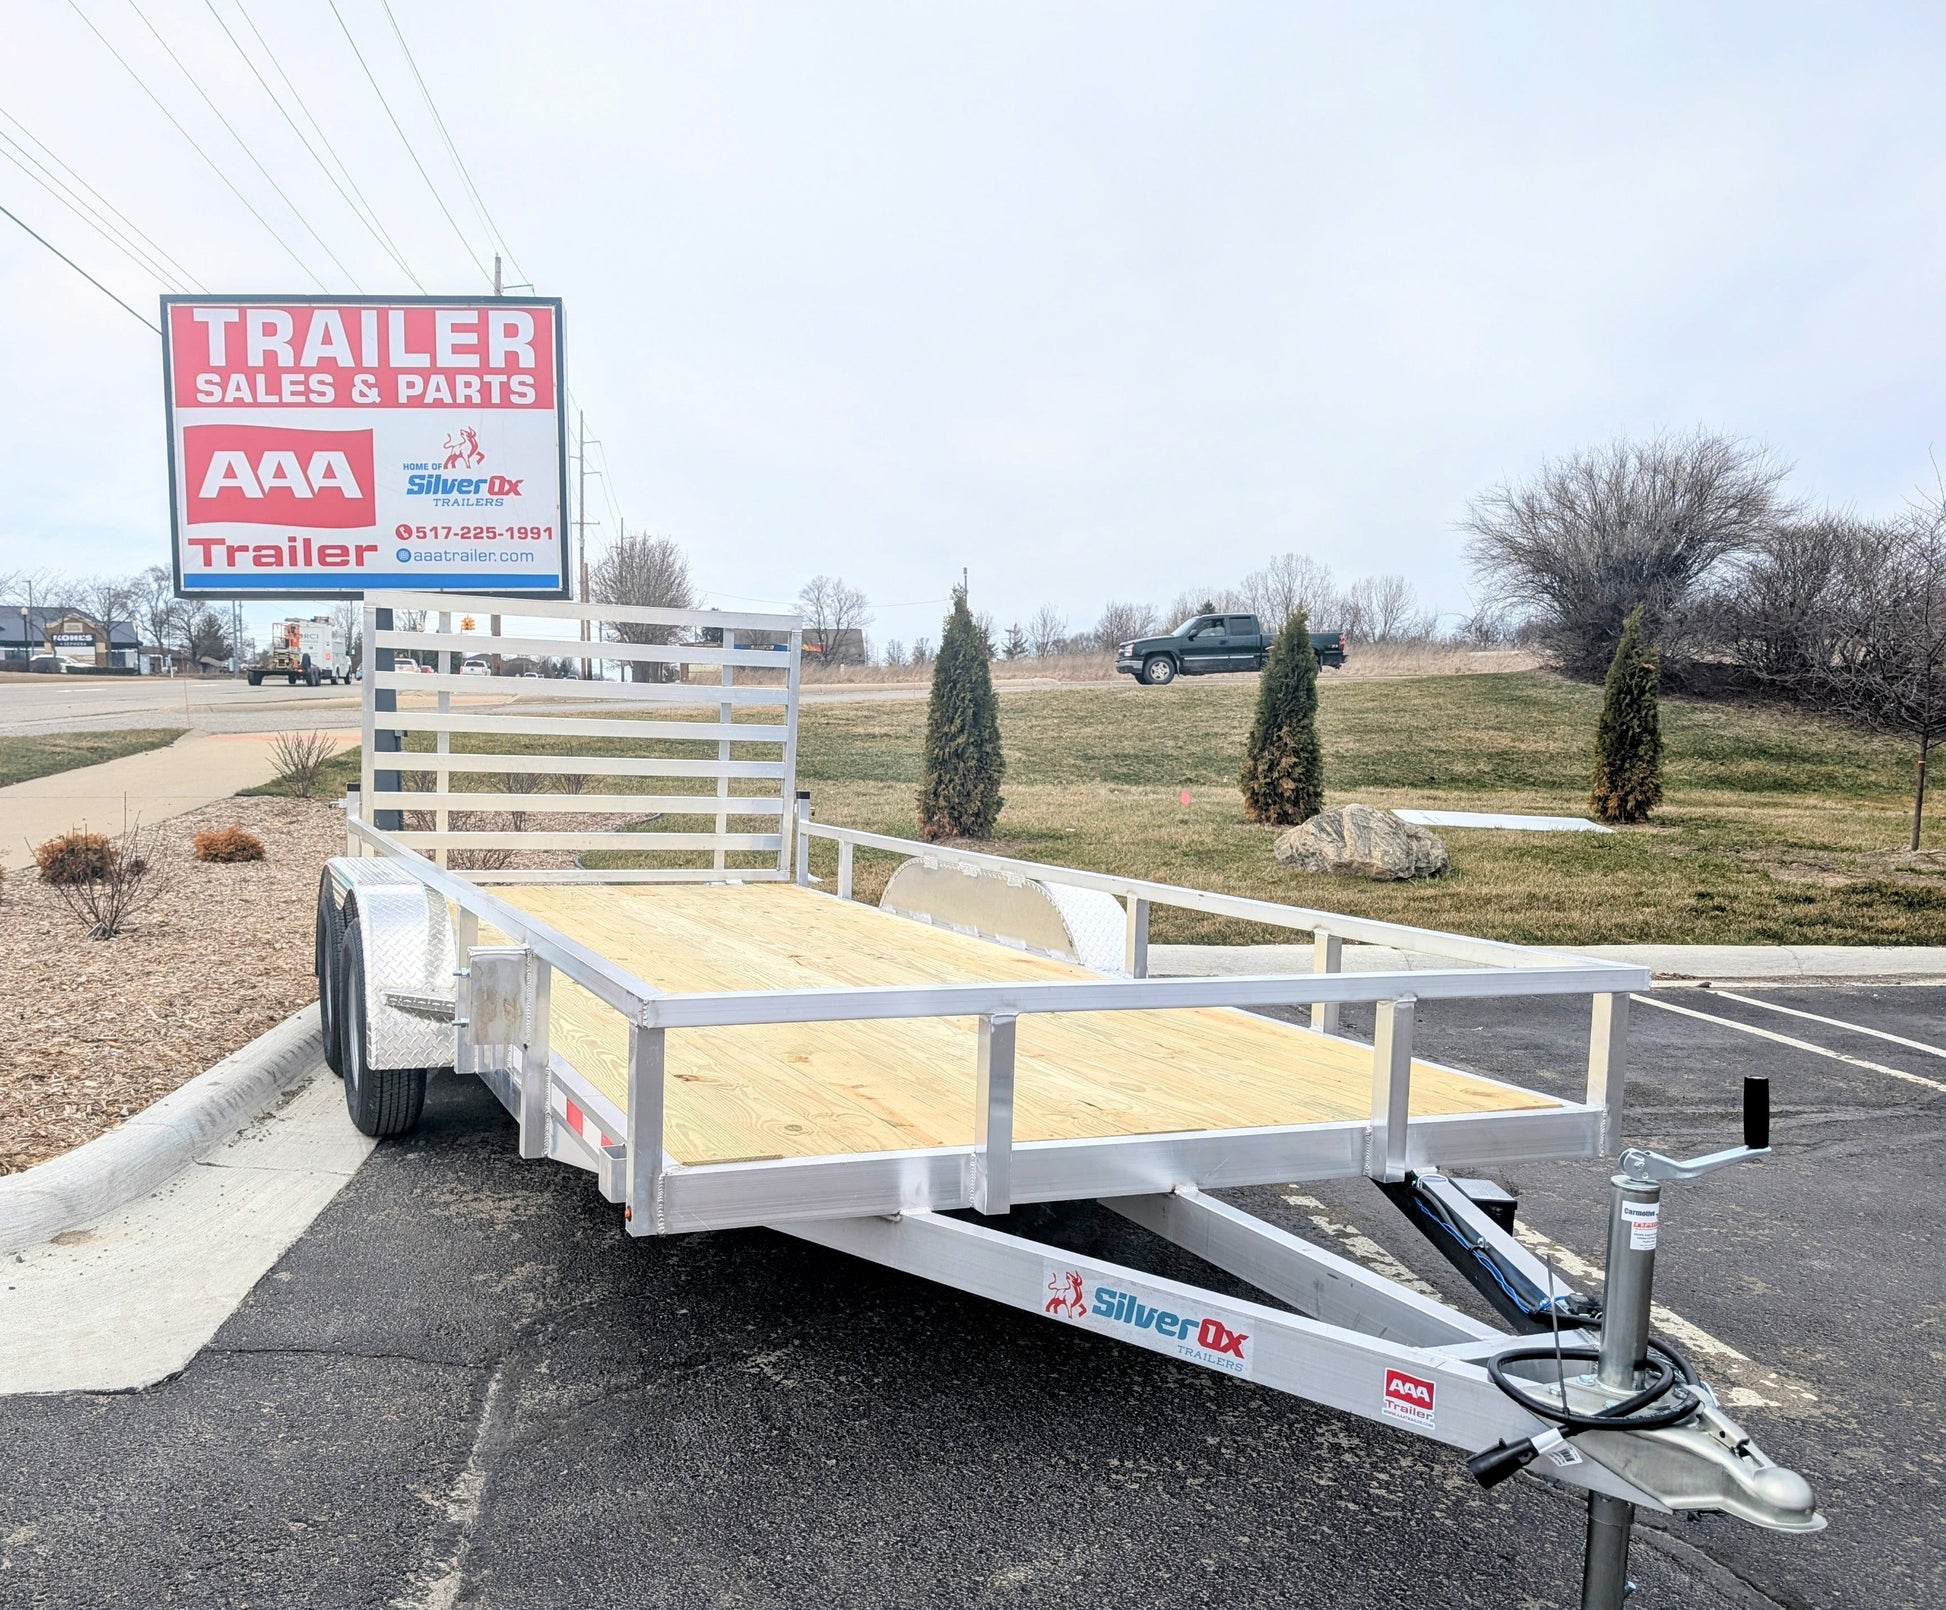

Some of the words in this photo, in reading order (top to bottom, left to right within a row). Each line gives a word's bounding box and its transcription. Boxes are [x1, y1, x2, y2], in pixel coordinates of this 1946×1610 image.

[193, 307, 536, 369] TRAILER
[195, 373, 335, 403] SALES
[352, 373, 381, 404] &
[398, 373, 536, 405] PARTS
[198, 450, 364, 499] AAA
[402, 462, 429, 471] HOME
[431, 462, 443, 471] OF
[405, 473, 525, 497] SilverOx
[433, 498, 505, 507] TRAILERS
[415, 525, 553, 541] 517-225-1991
[187, 536, 378, 567] Trailer
[413, 548, 535, 563] aaatrailer.com
[1091, 1286, 1250, 1360] SilverOx
[1177, 1343, 1244, 1373] TRAILERS
[1388, 1378, 1431, 1403] AAA
[1384, 1398, 1434, 1420] Trailer
